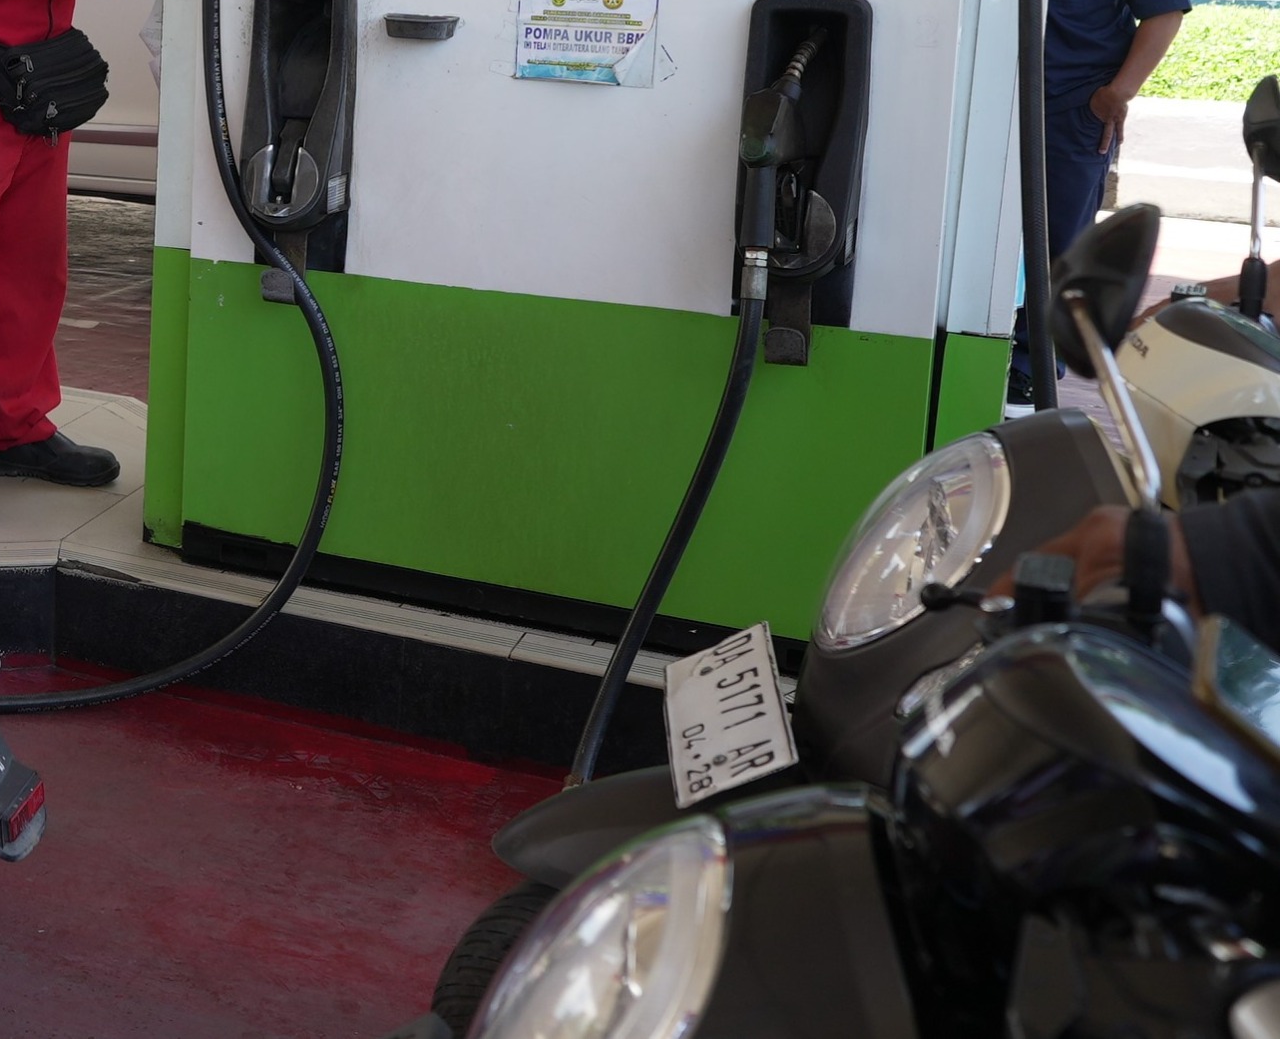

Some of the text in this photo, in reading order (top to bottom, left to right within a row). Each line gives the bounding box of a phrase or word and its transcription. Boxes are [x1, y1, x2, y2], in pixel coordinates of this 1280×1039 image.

[525, 27, 645, 45] POMPA UKUR BBM
[533, 41, 551, 50] TELAH
[712, 632, 775, 778] DA 5171 AR
